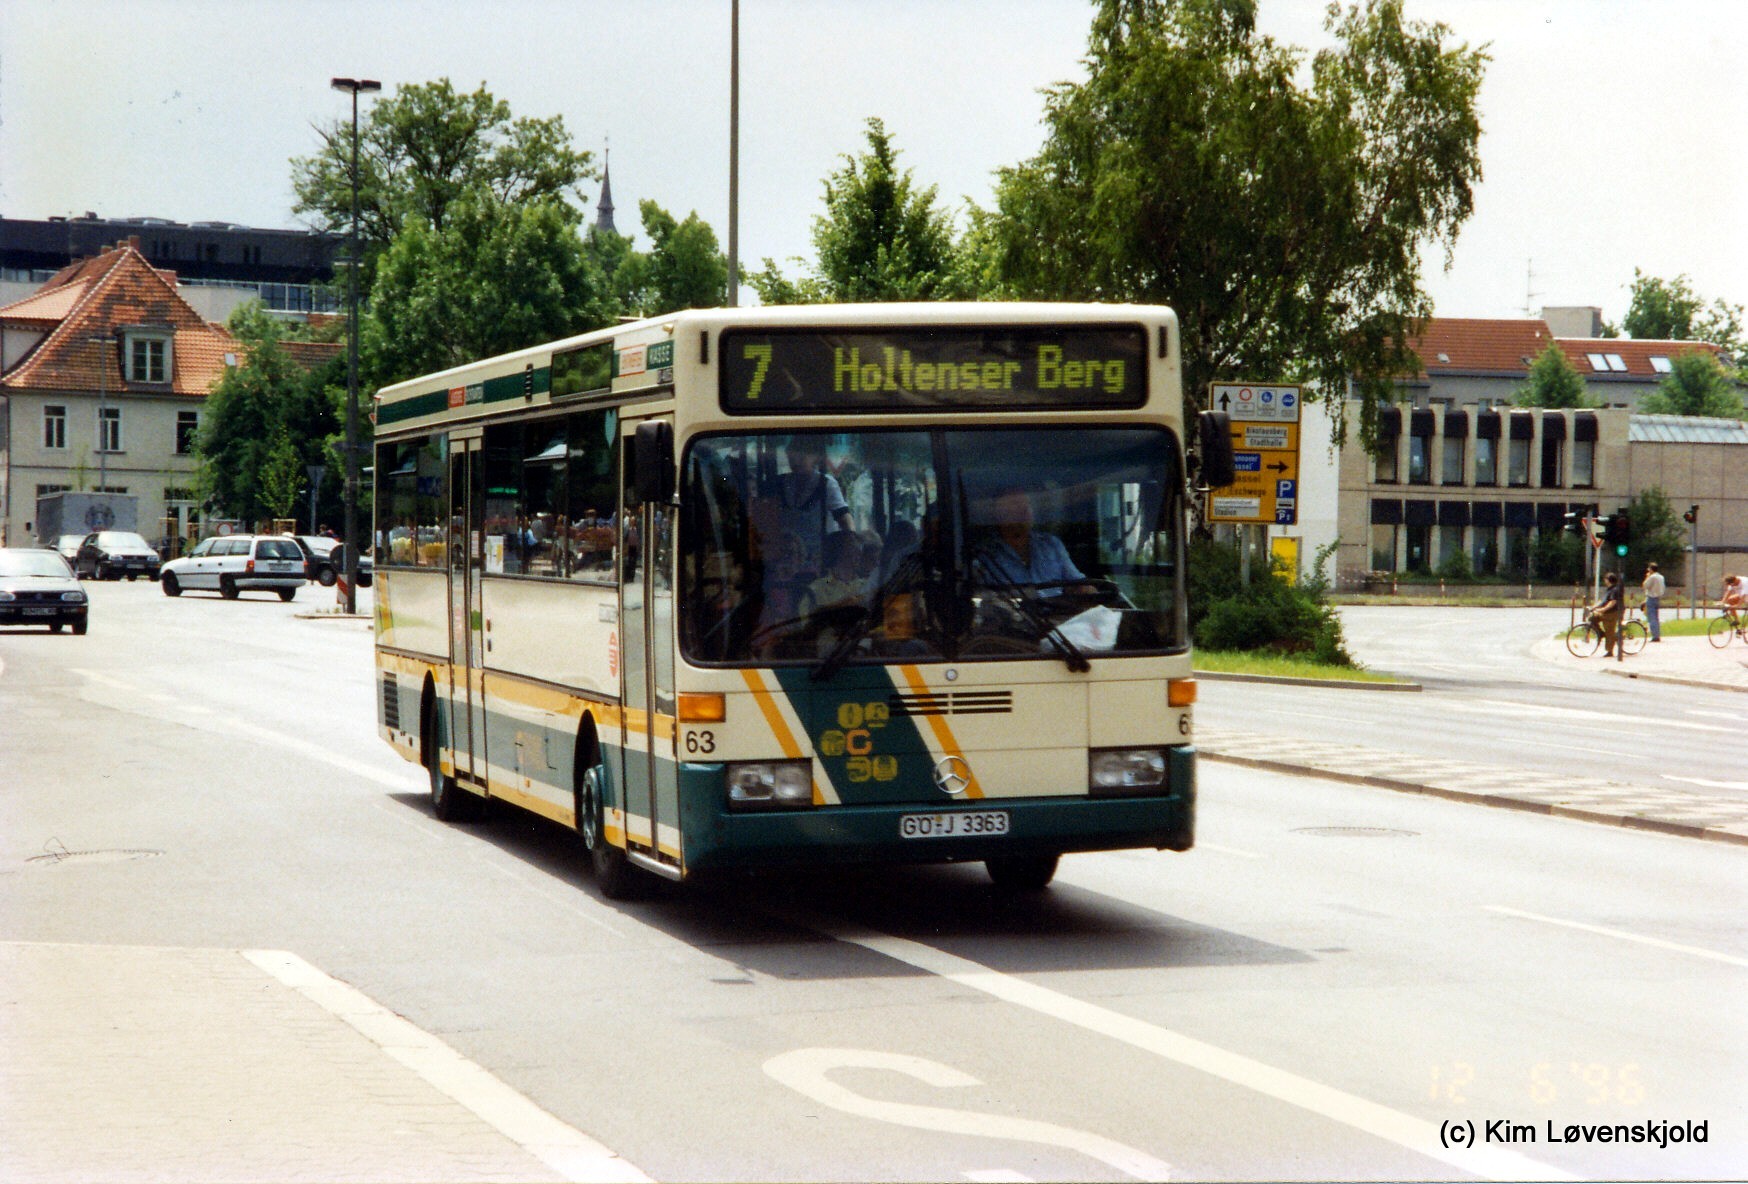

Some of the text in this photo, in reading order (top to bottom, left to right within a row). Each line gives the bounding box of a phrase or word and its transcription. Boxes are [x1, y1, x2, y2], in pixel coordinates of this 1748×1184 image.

[744, 345, 1125, 399] 7 Holtenser Berg
[1178, 713, 1192, 736] 6
[686, 730, 716, 754] 63
[963, 815, 1005, 832] 3363
